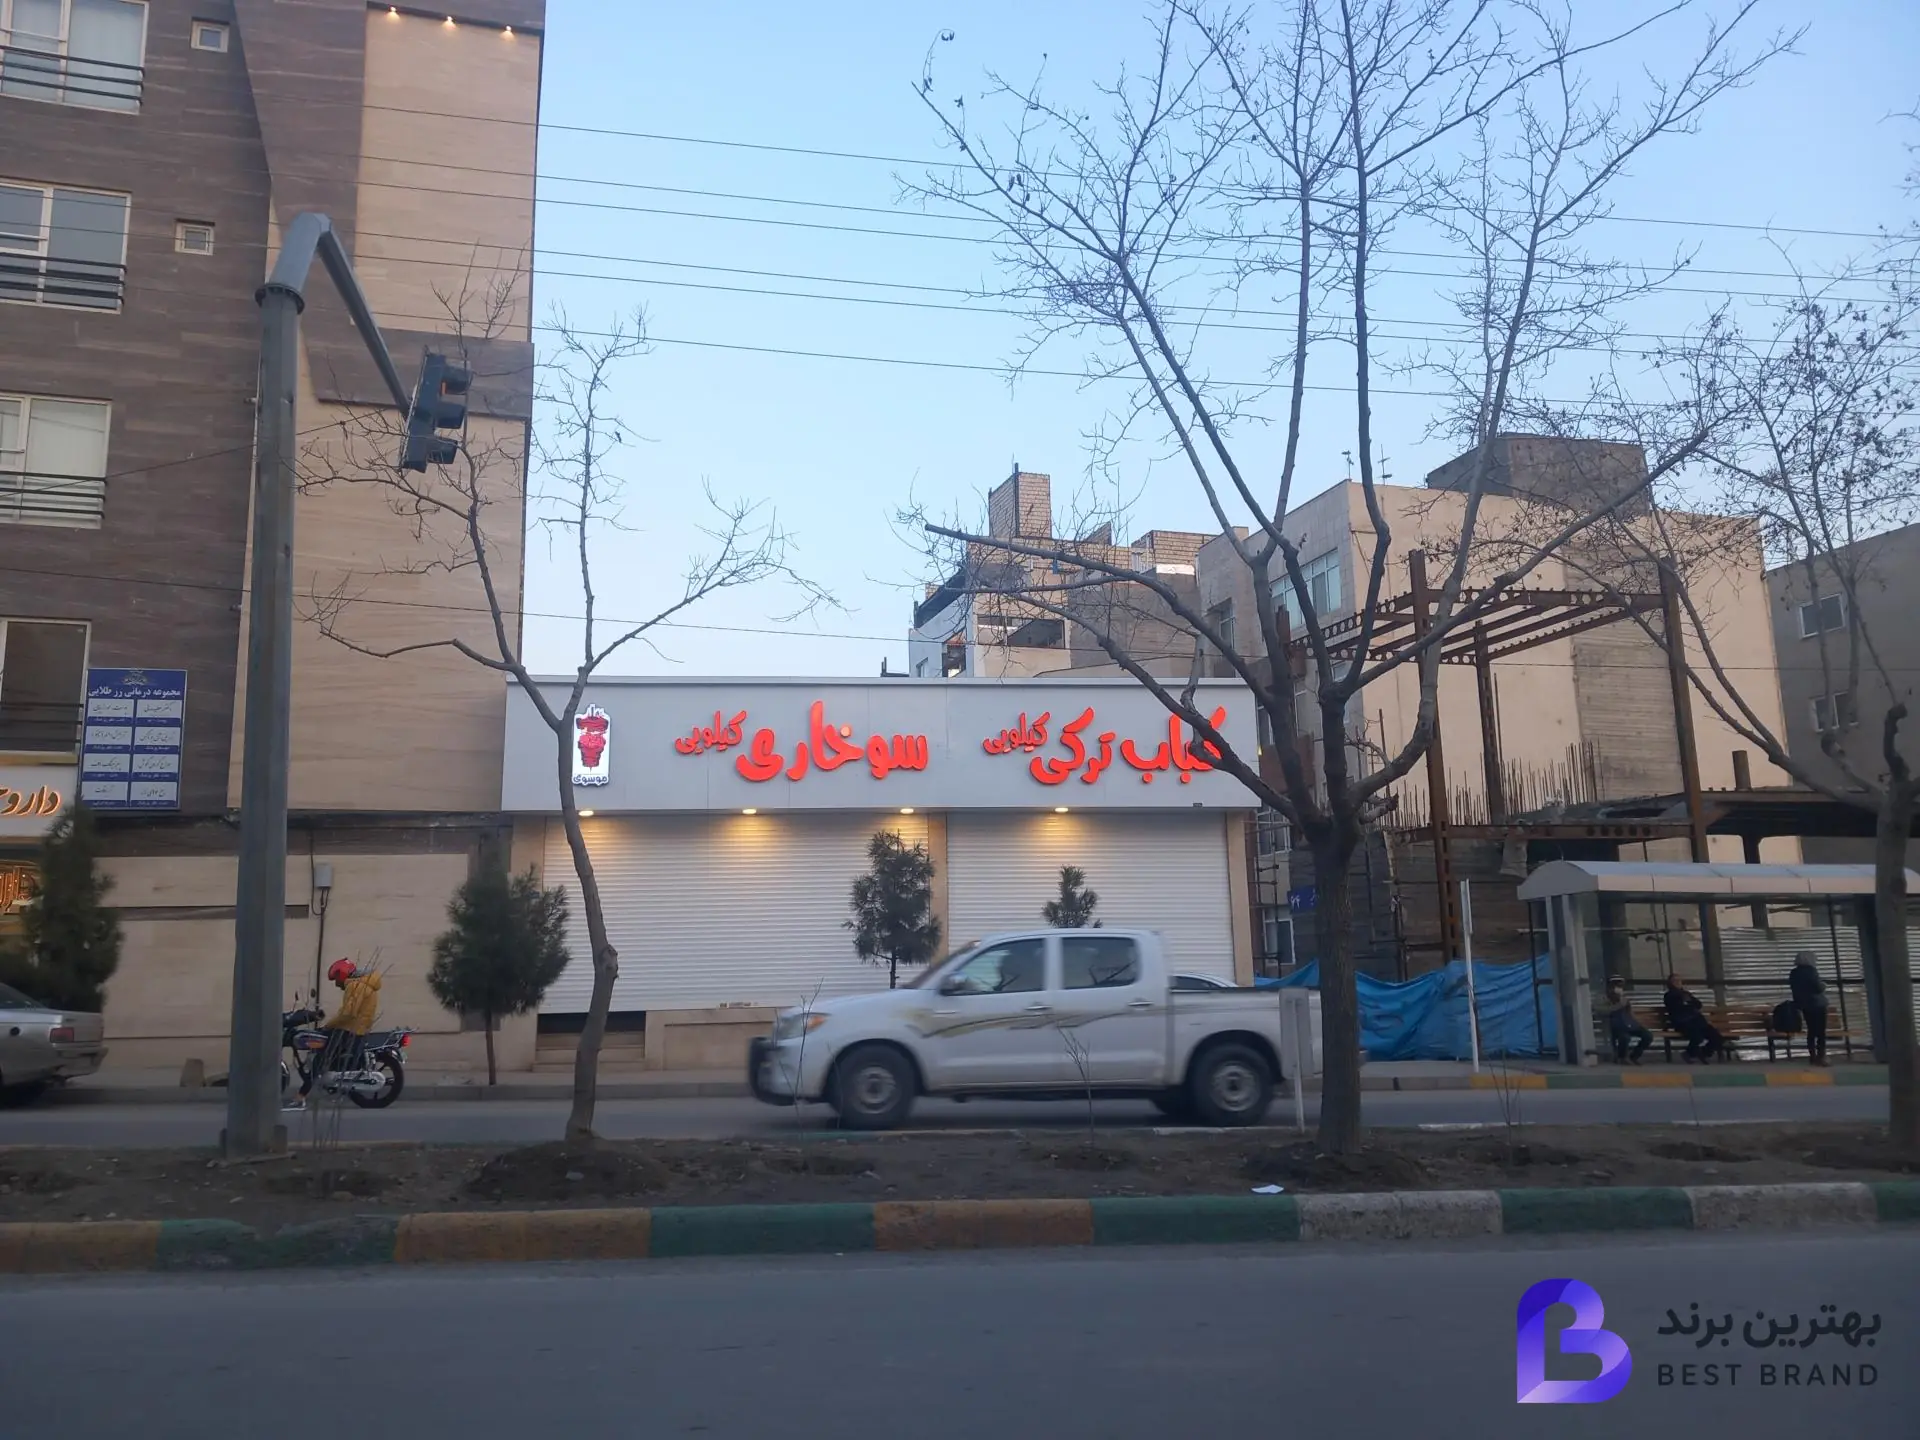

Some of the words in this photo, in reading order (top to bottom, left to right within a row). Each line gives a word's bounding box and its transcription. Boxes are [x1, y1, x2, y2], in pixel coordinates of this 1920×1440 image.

[124, 687, 151, 698] درمانی
[153, 688, 180, 698] مجموعه
[675, 710, 747, 755] کیلویی
[736, 701, 929, 782] سوخاری
[983, 712, 1050, 755] کیلویی
[1030, 708, 1117, 784] ترکی
